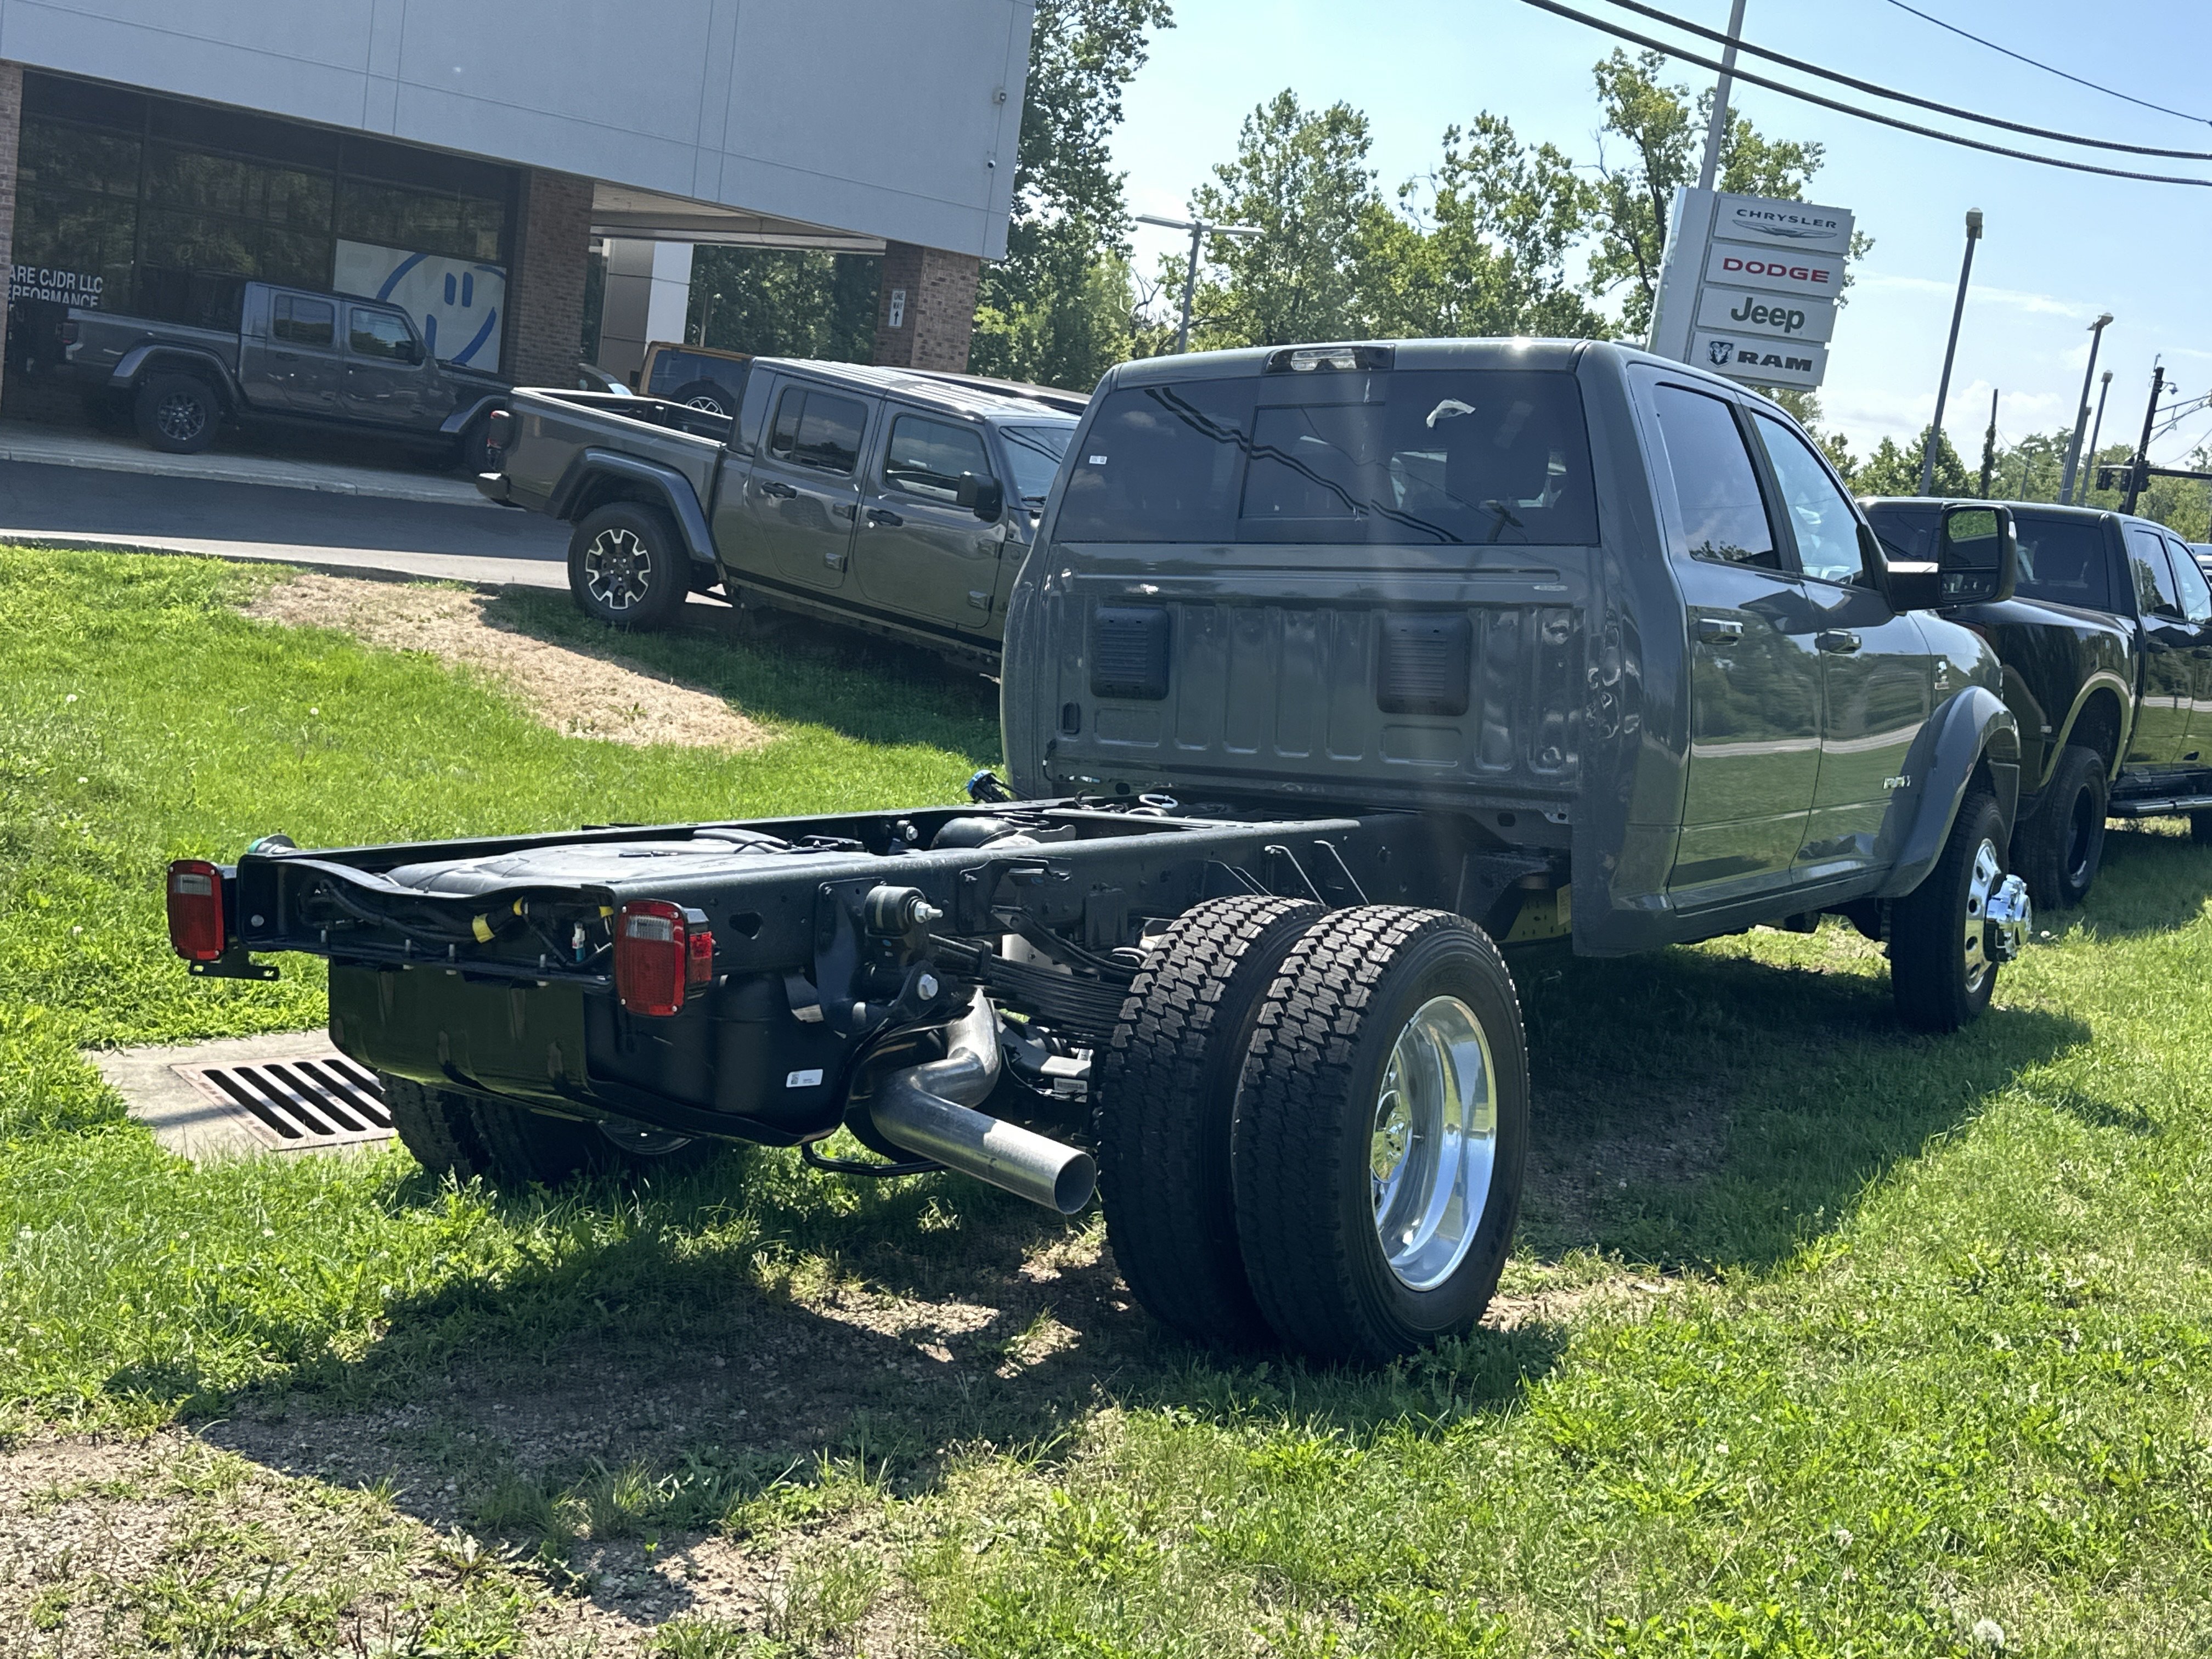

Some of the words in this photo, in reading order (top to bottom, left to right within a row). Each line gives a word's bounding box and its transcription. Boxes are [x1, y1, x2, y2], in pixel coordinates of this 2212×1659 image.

[1736, 208, 1837, 229] CHRYSLER
[40, 269, 76, 290] CJDR
[80, 274, 103, 294] LLC
[1723, 258, 1830, 284] DODGE
[1730, 297, 1805, 333] Jeep
[1737, 350, 1813, 371] RAM
